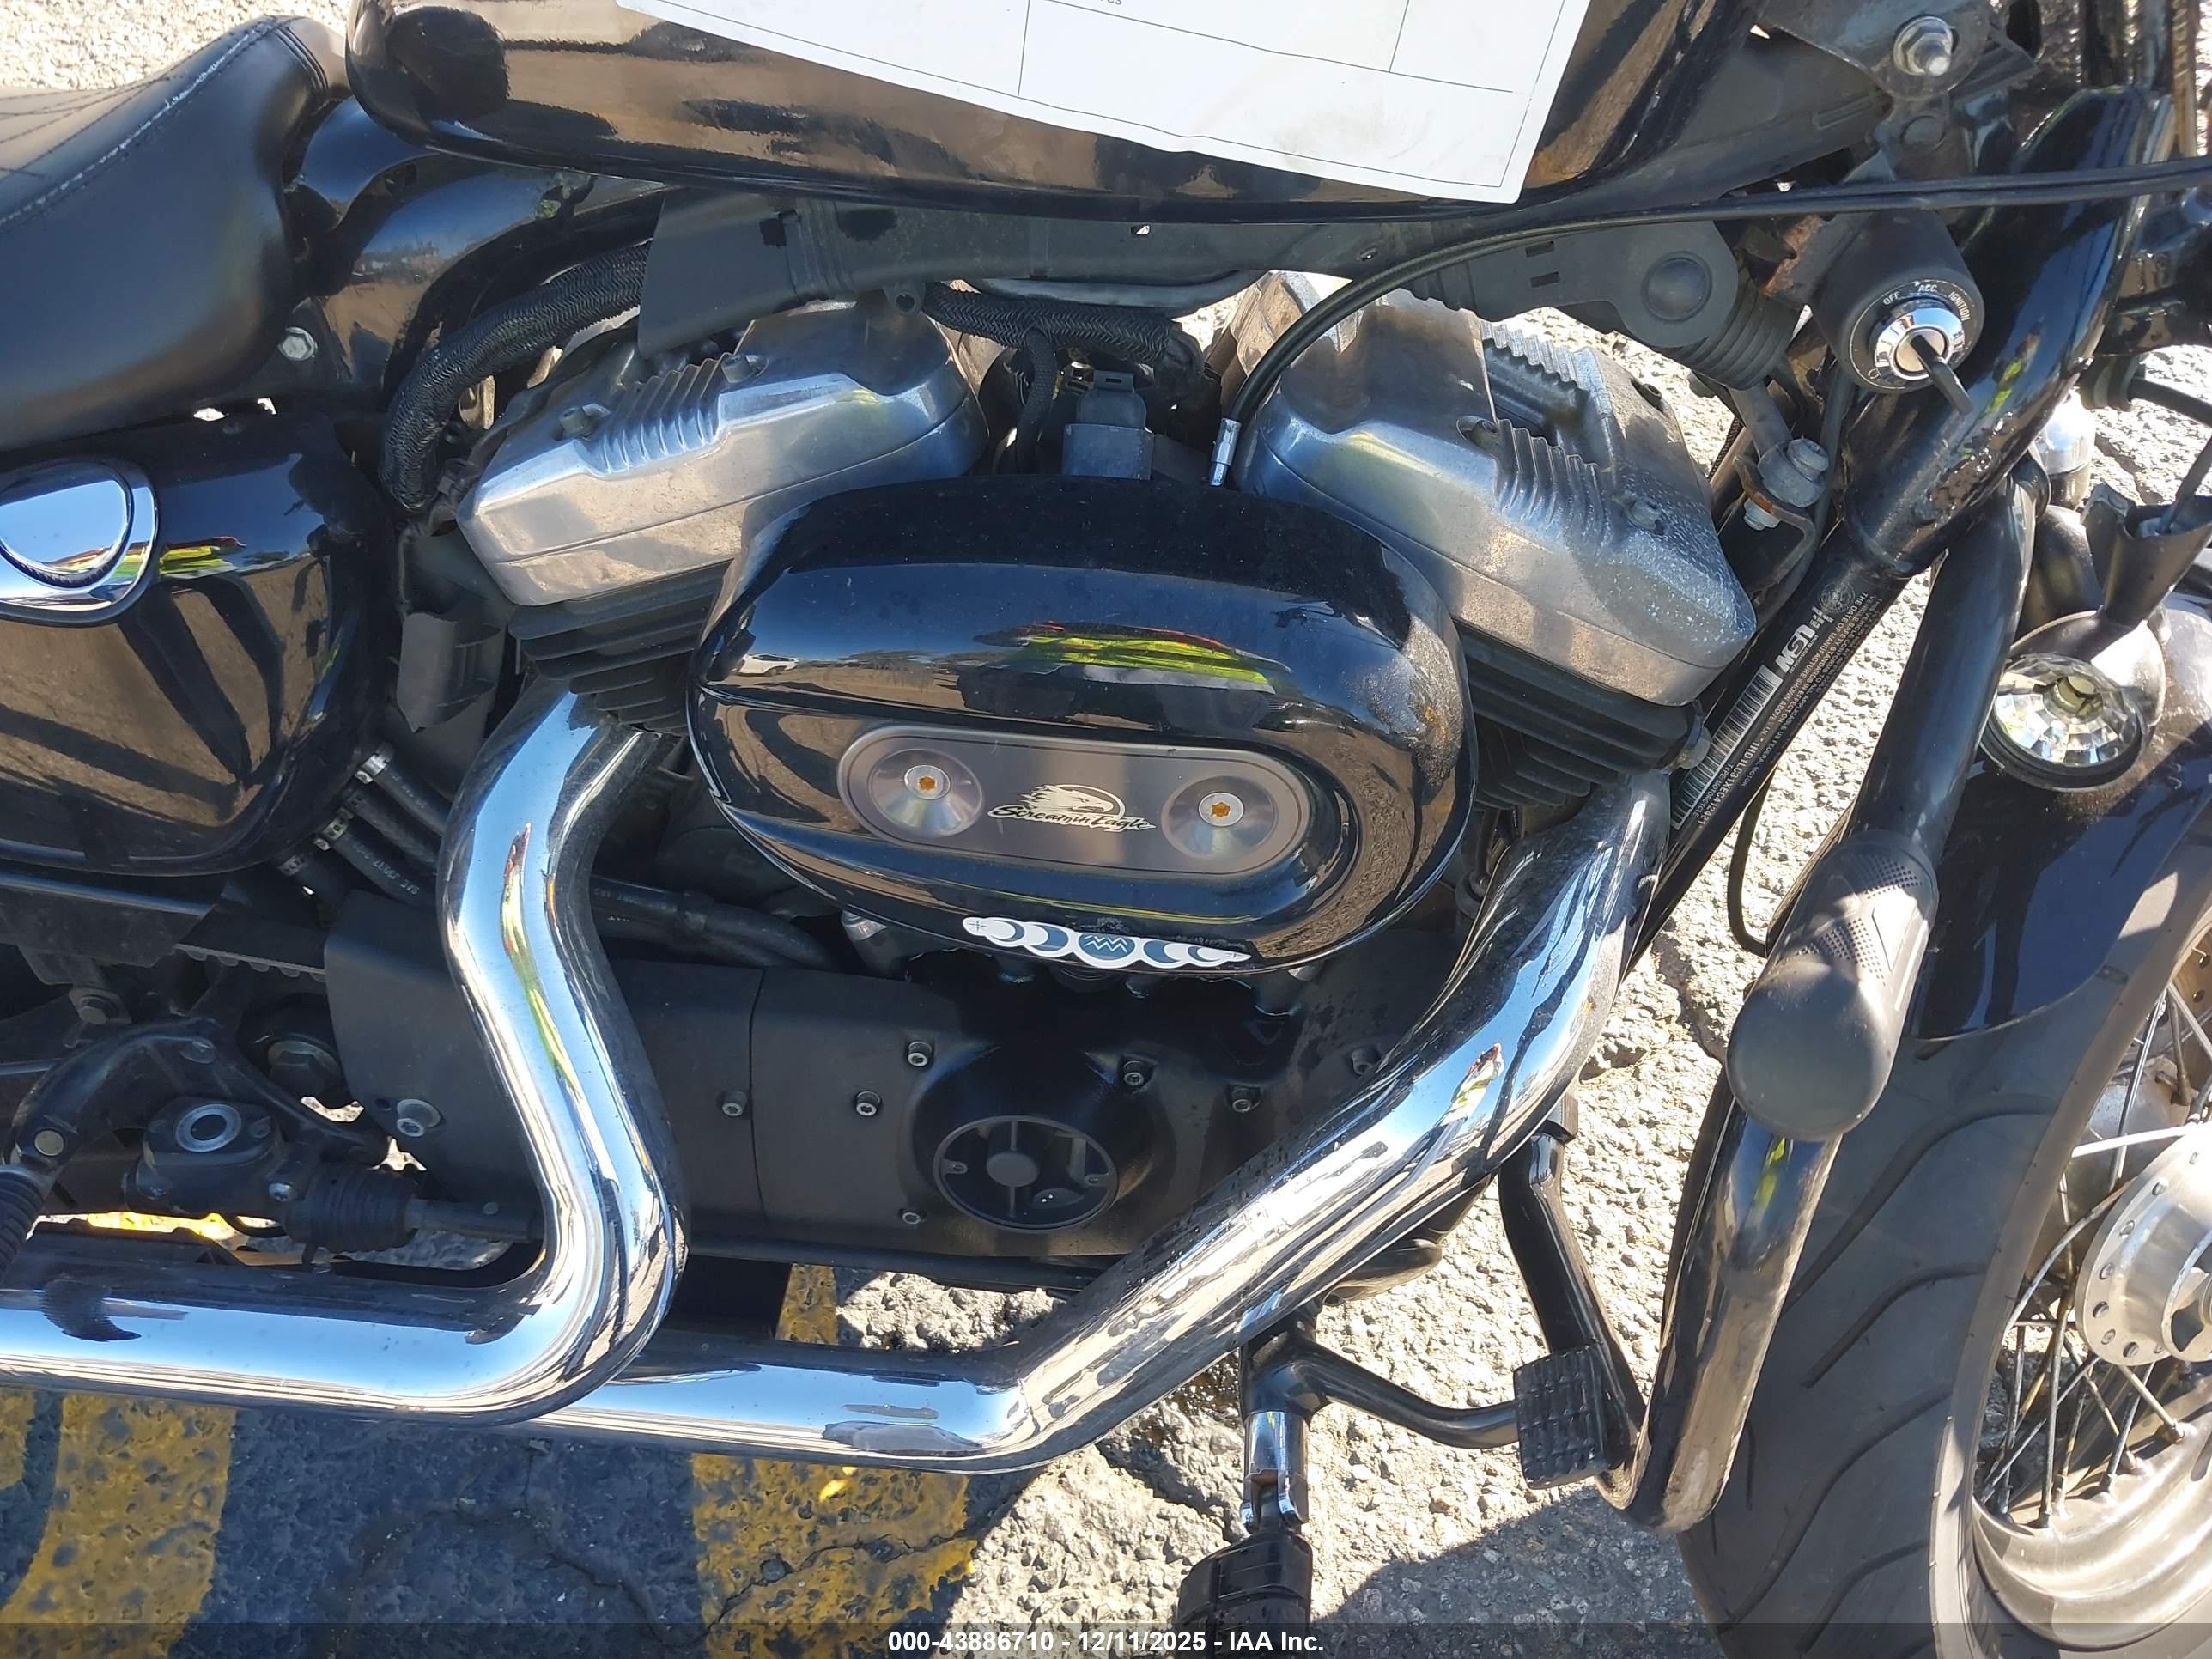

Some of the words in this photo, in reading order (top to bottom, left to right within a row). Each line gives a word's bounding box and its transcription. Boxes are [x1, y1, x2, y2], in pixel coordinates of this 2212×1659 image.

[1883, 291, 1901, 306] OFF
[1948, 291, 1972, 322] IGNITION
[1854, 590, 1869, 606] THE
[1840, 604, 1858, 624] DATE
[1833, 621, 1844, 633] OF
[1834, 620, 1856, 647] SAFETY
[1798, 630, 1837, 679] MANUFACTURE
[1806, 645, 1837, 684] STANDARDS
[1783, 677, 1803, 702] SHOWN
[1784, 689, 1805, 714] EFFECT
[1768, 699, 1787, 721] ABOVE
[1777, 712, 1788, 724] ON
[1692, 778, 1723, 817] MOTORCYCLE
[1091, 815, 1151, 831] Eagle
